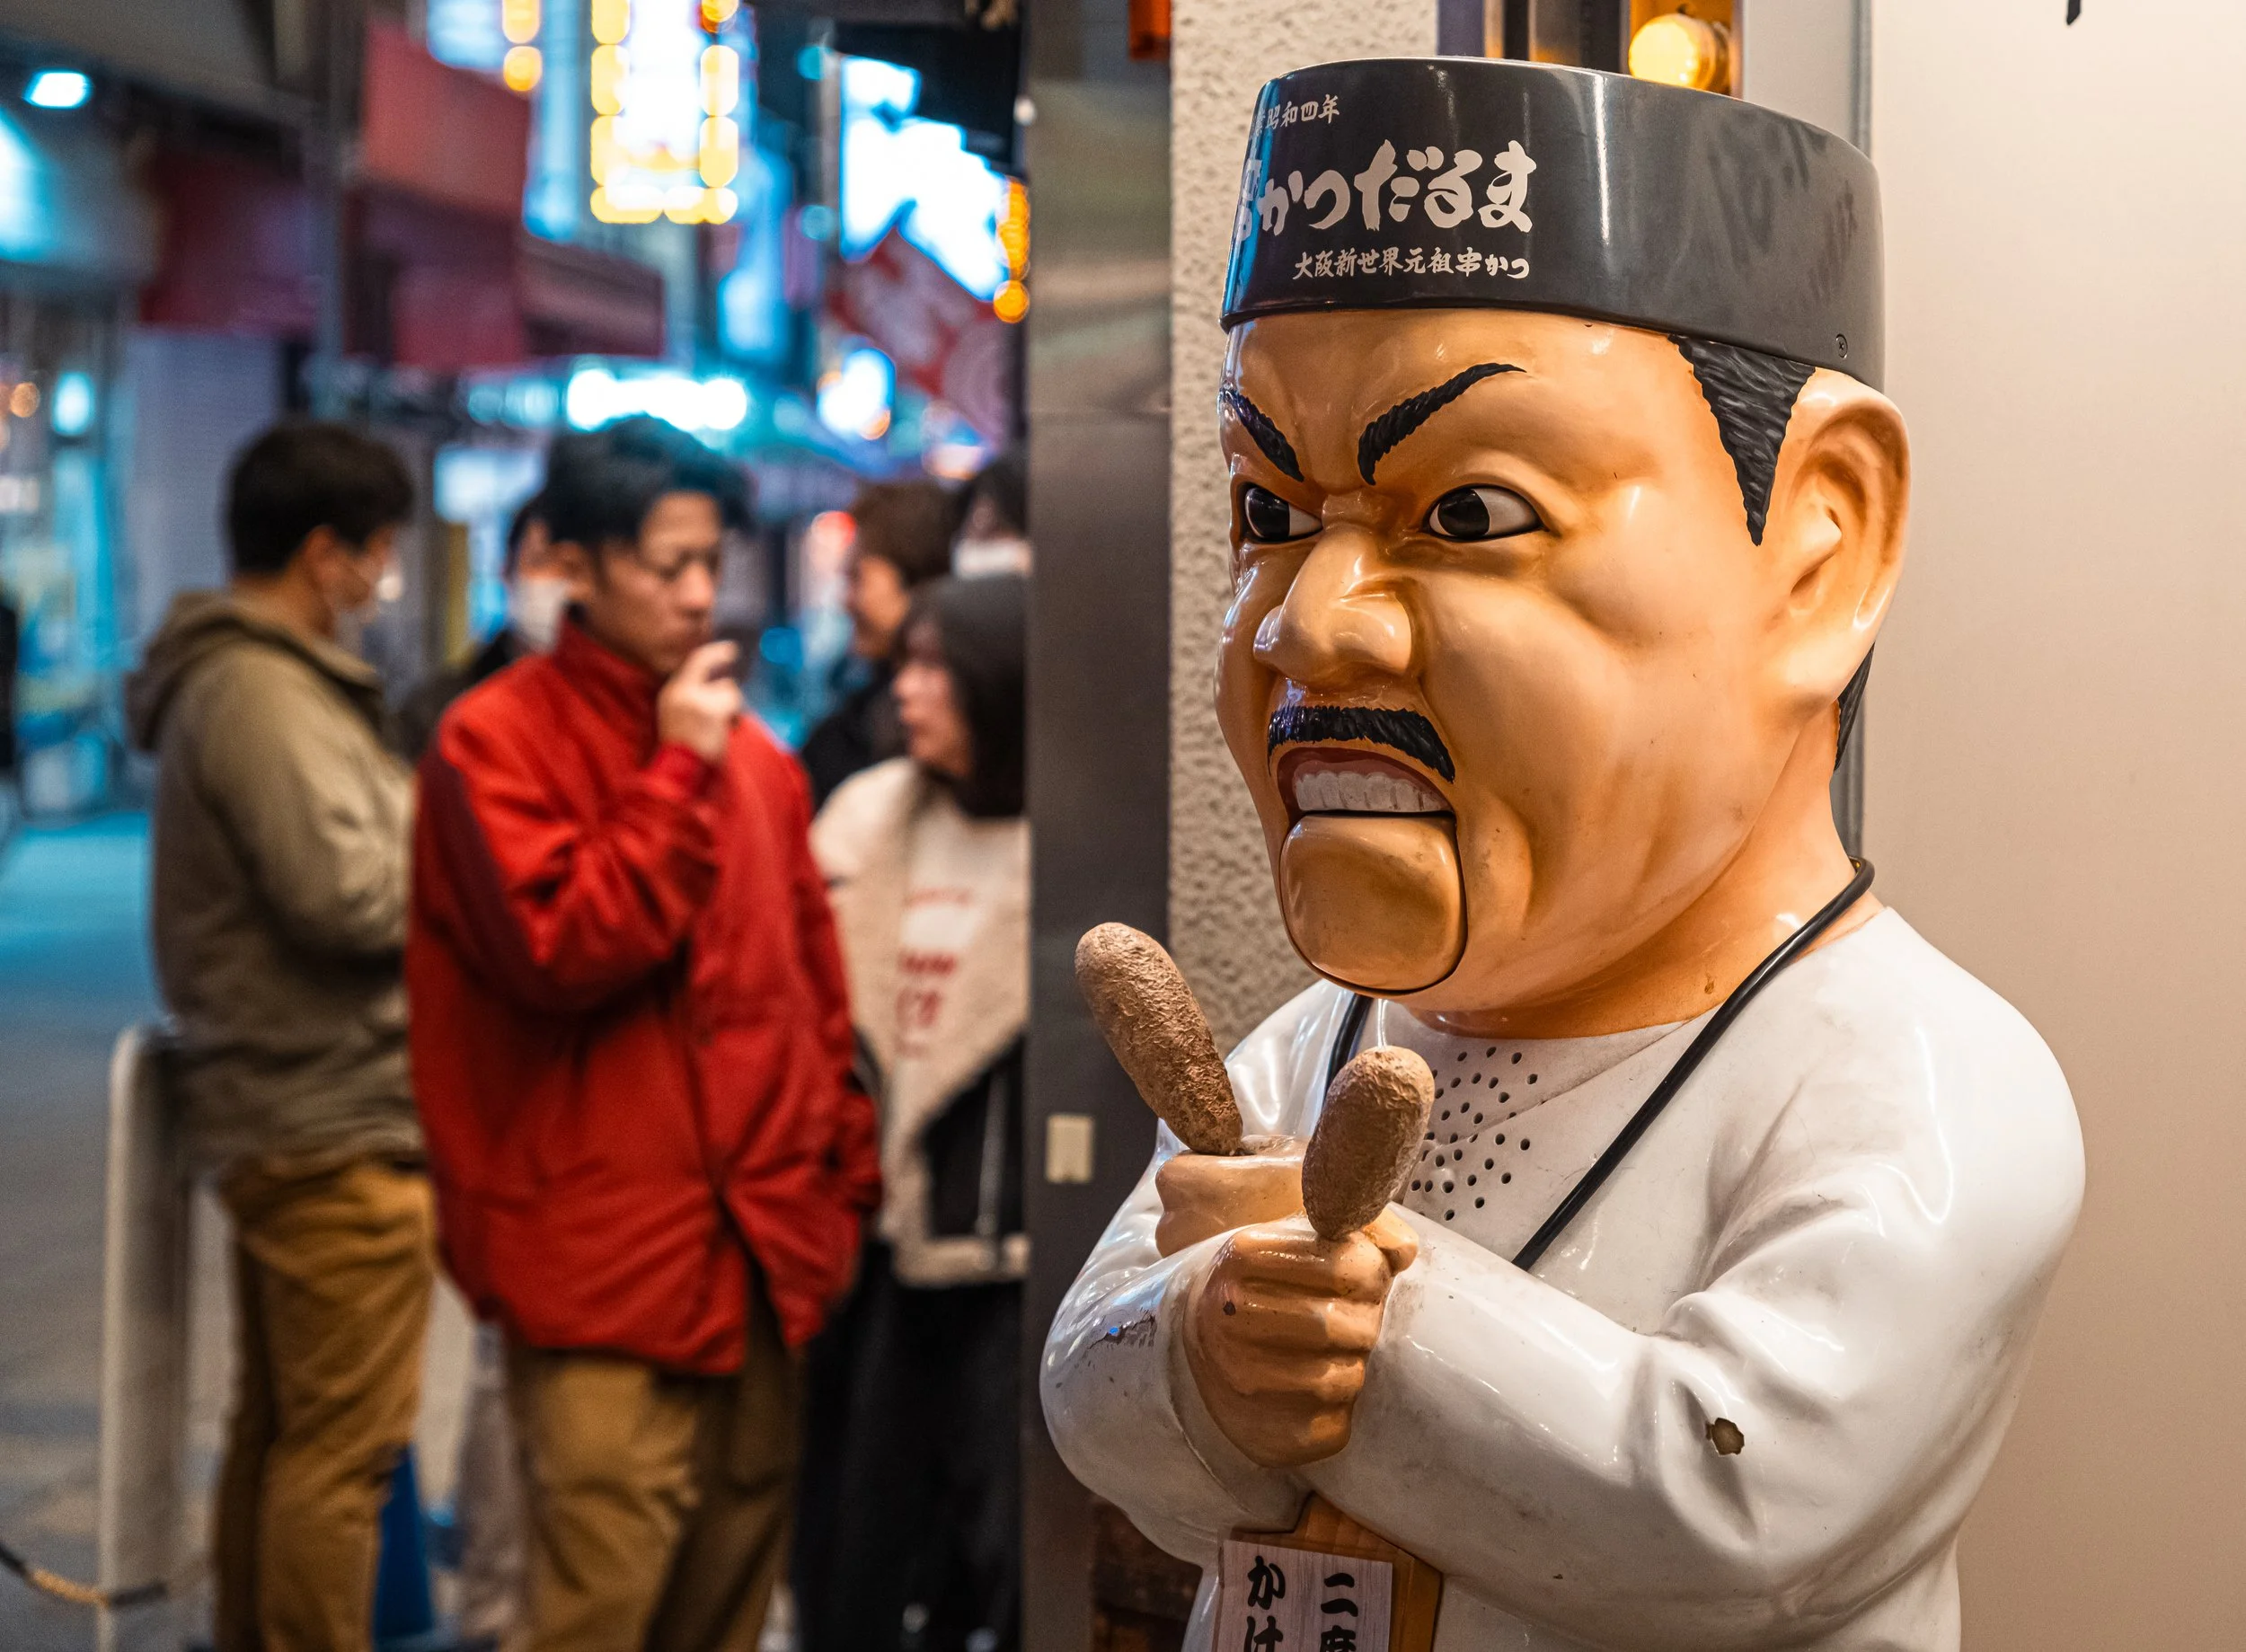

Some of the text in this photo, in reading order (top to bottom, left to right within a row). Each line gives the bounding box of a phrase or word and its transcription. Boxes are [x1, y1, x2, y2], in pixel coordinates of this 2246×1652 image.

[1292, 246, 1530, 280] 大阪新世界元祖串かつ
